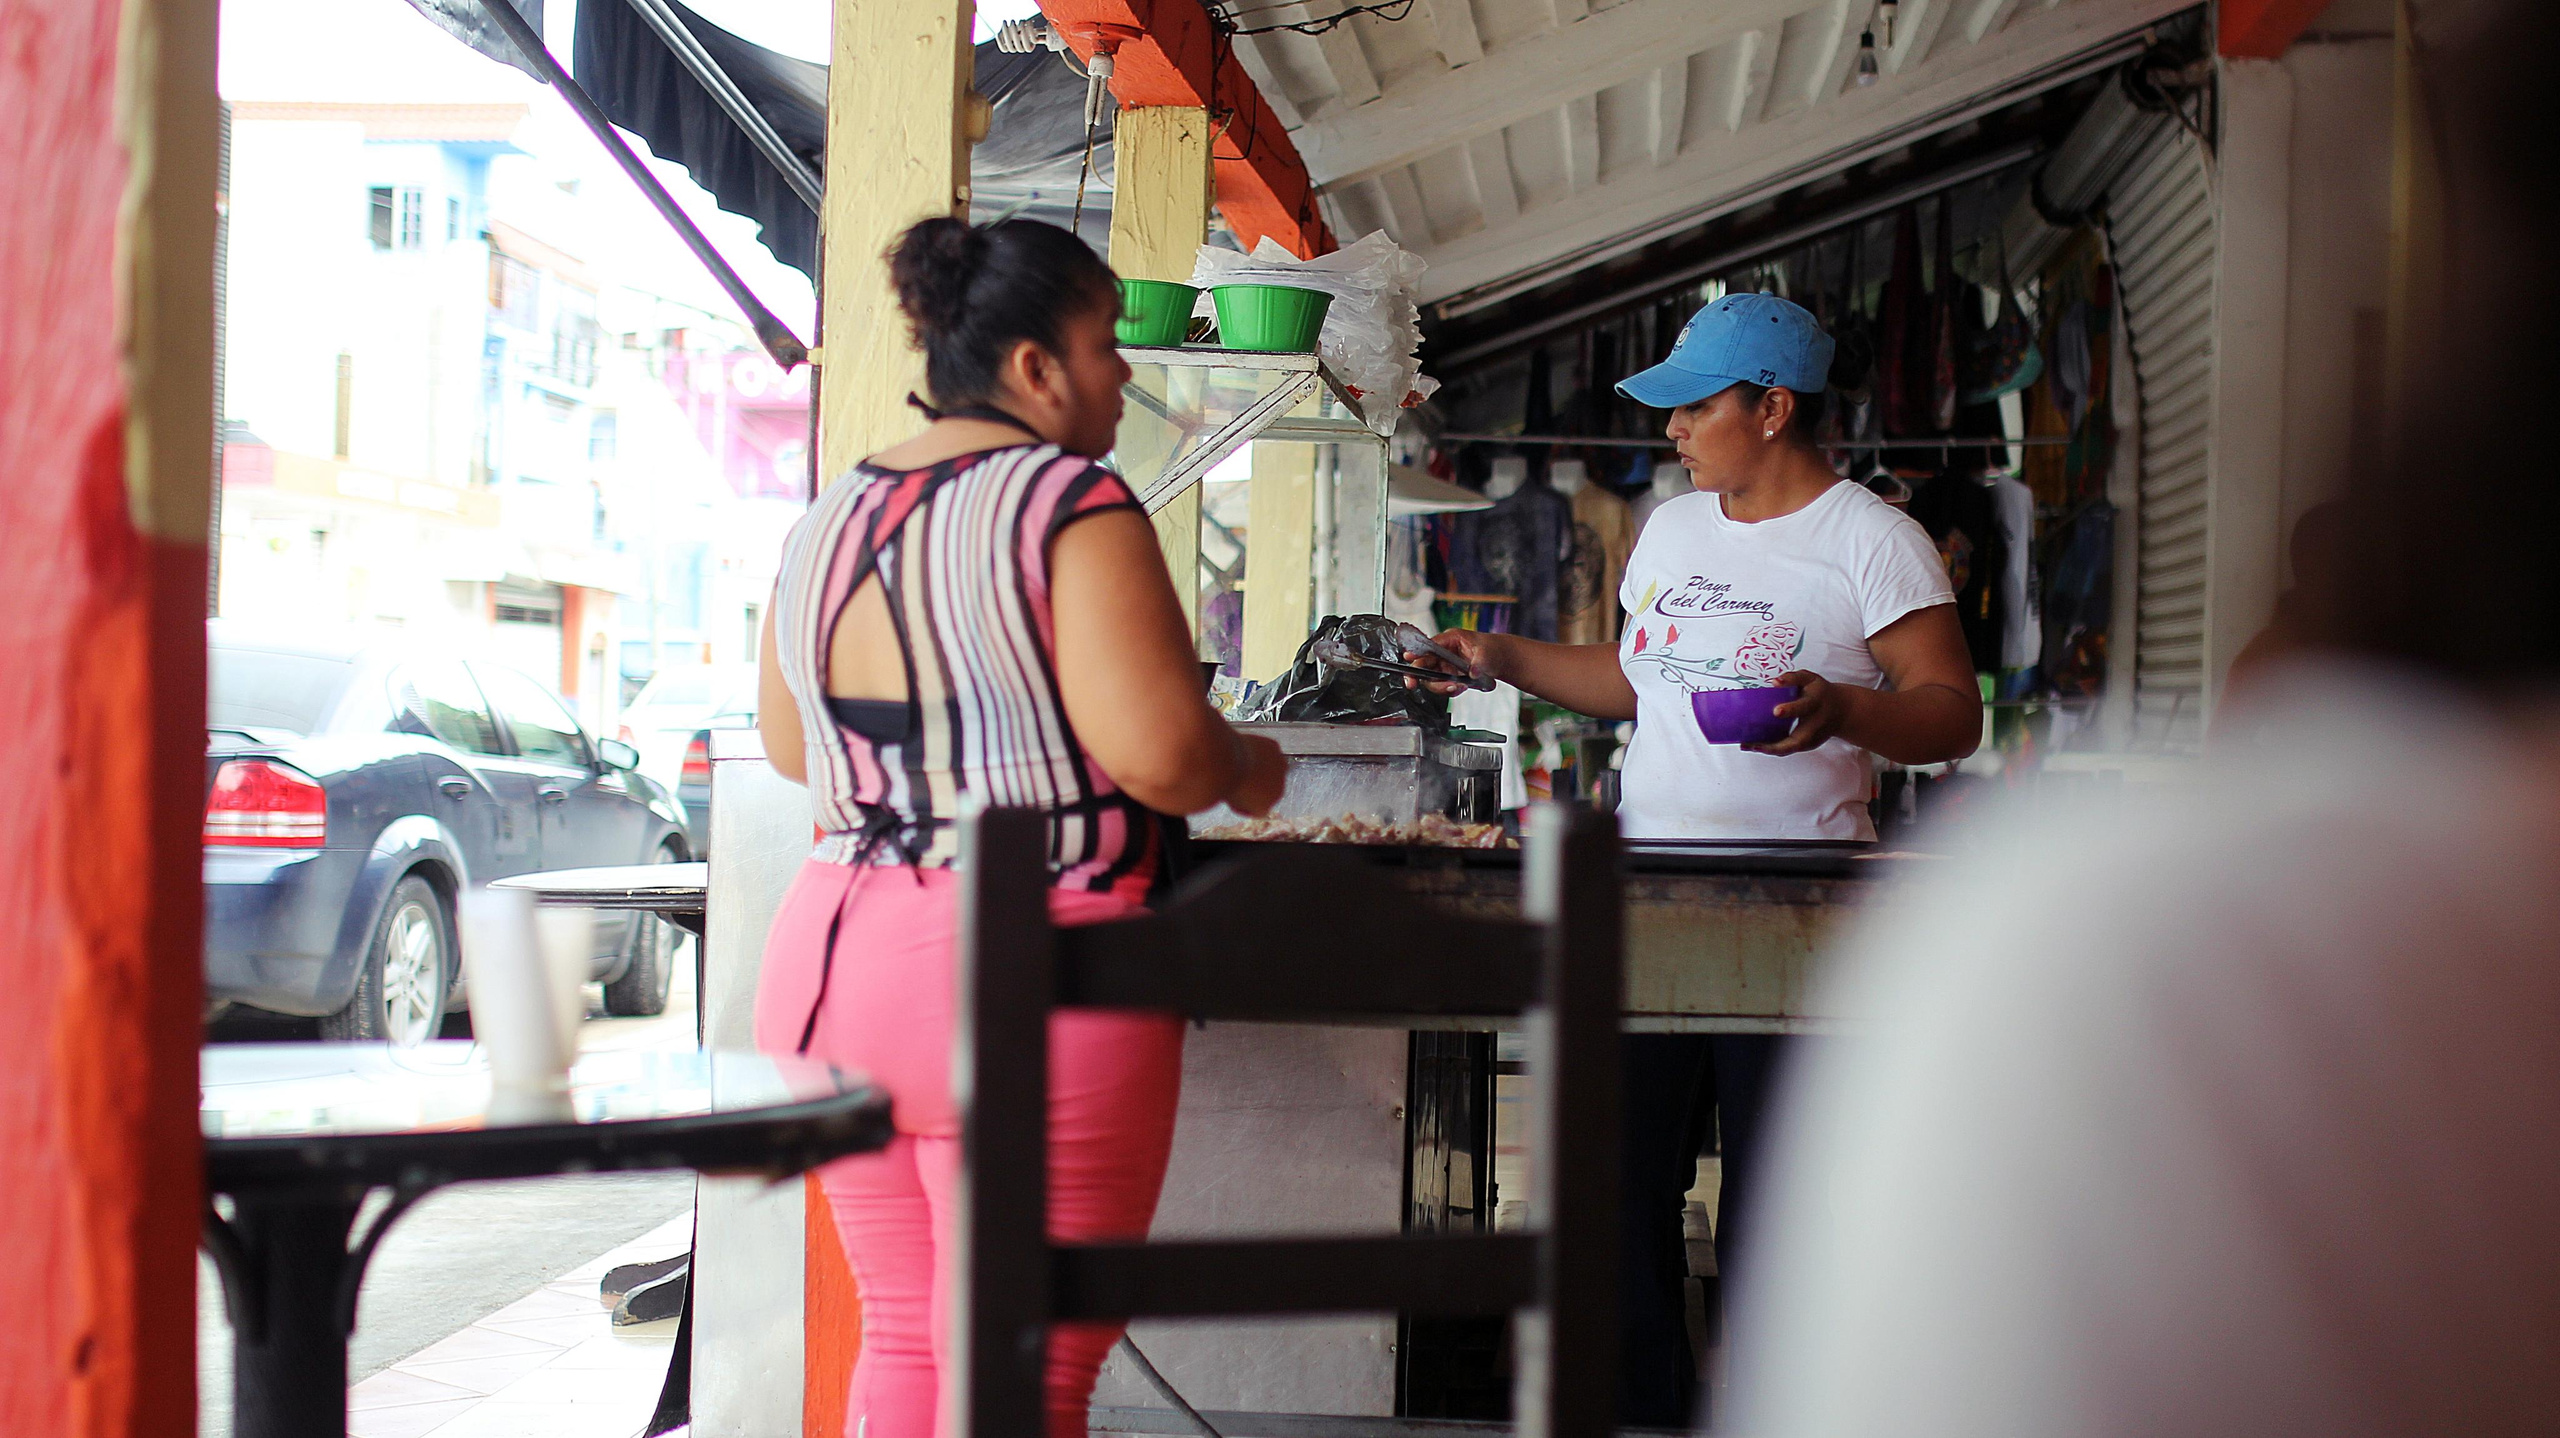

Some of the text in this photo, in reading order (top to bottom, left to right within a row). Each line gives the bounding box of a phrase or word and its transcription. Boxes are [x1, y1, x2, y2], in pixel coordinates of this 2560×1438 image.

[1759, 369, 1776, 385] 72
[1685, 575, 1732, 594] Playa
[1670, 593, 1775, 616] del Carmen
